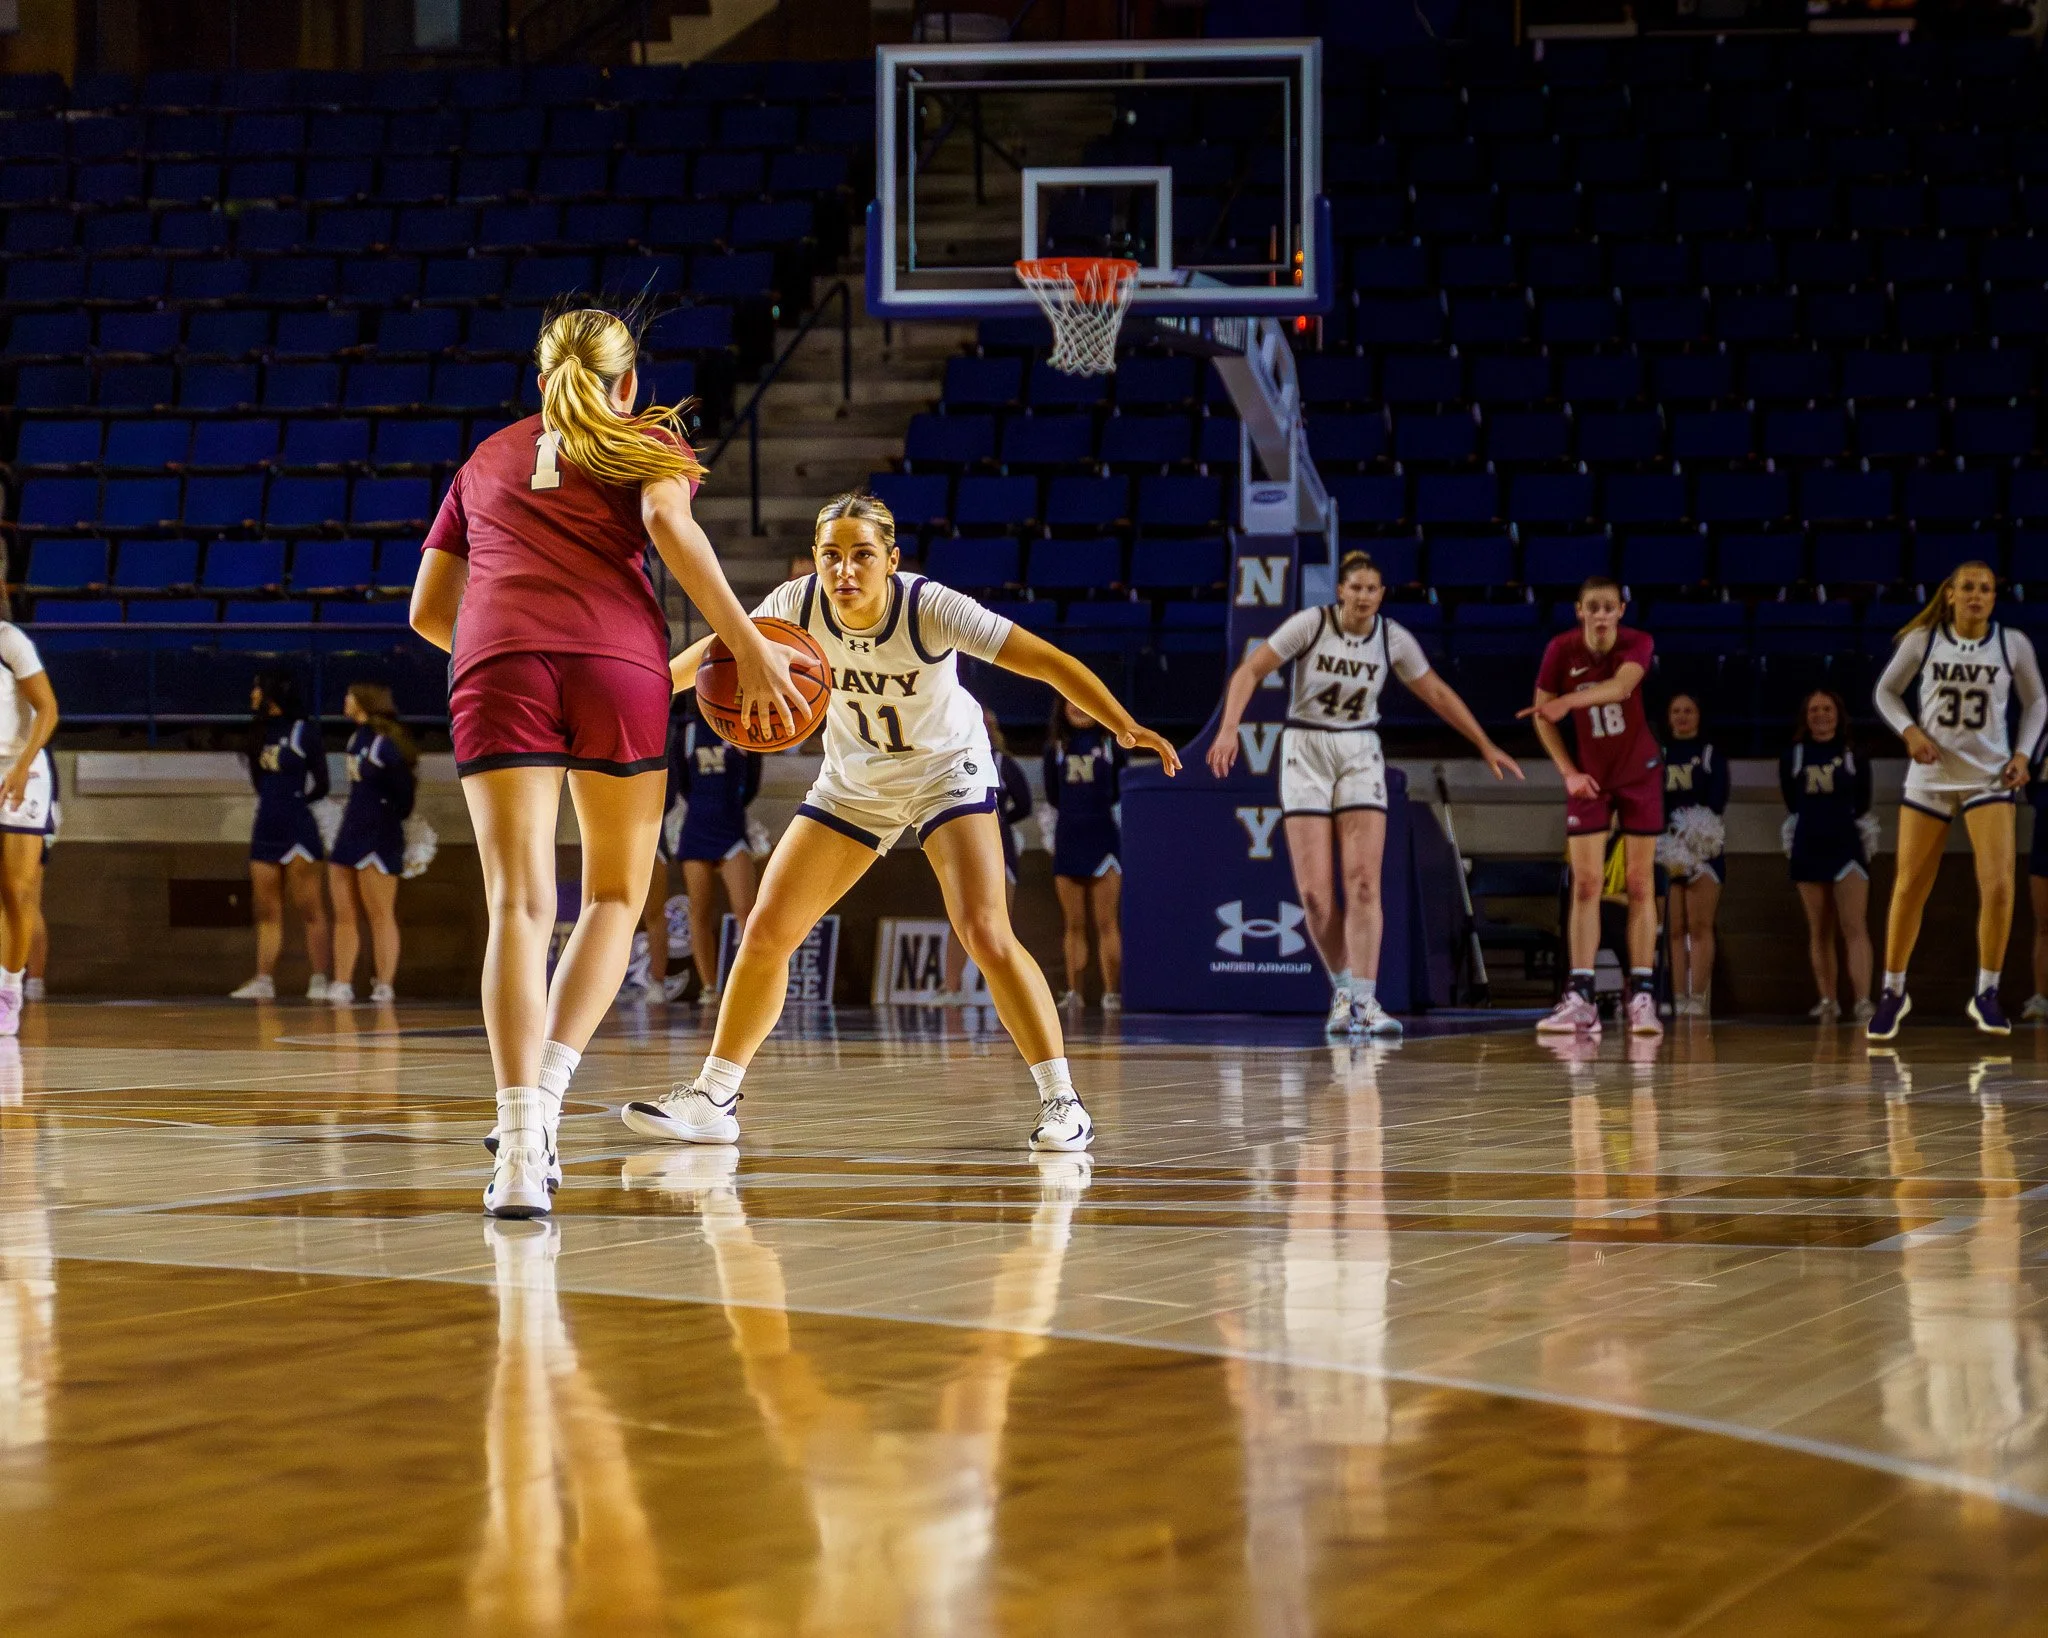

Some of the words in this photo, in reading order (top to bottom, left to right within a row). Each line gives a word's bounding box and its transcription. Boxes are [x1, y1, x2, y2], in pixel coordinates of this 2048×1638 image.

[1316, 654, 1379, 681] NAVY
[1933, 662, 2000, 684] NAVY
[1235, 557, 1289, 859] NVY
[1317, 681, 1369, 722] 44
[1937, 687, 1989, 730] 33
[845, 699, 915, 754] 11
[1588, 702, 1627, 739] 18
[696, 745, 727, 776] N
[1065, 754, 1096, 784] N
[1665, 764, 1694, 791] N
[1803, 763, 1835, 795] N
[1210, 961, 1255, 973] UNDER
[1257, 962, 1312, 974] ARMOUR
